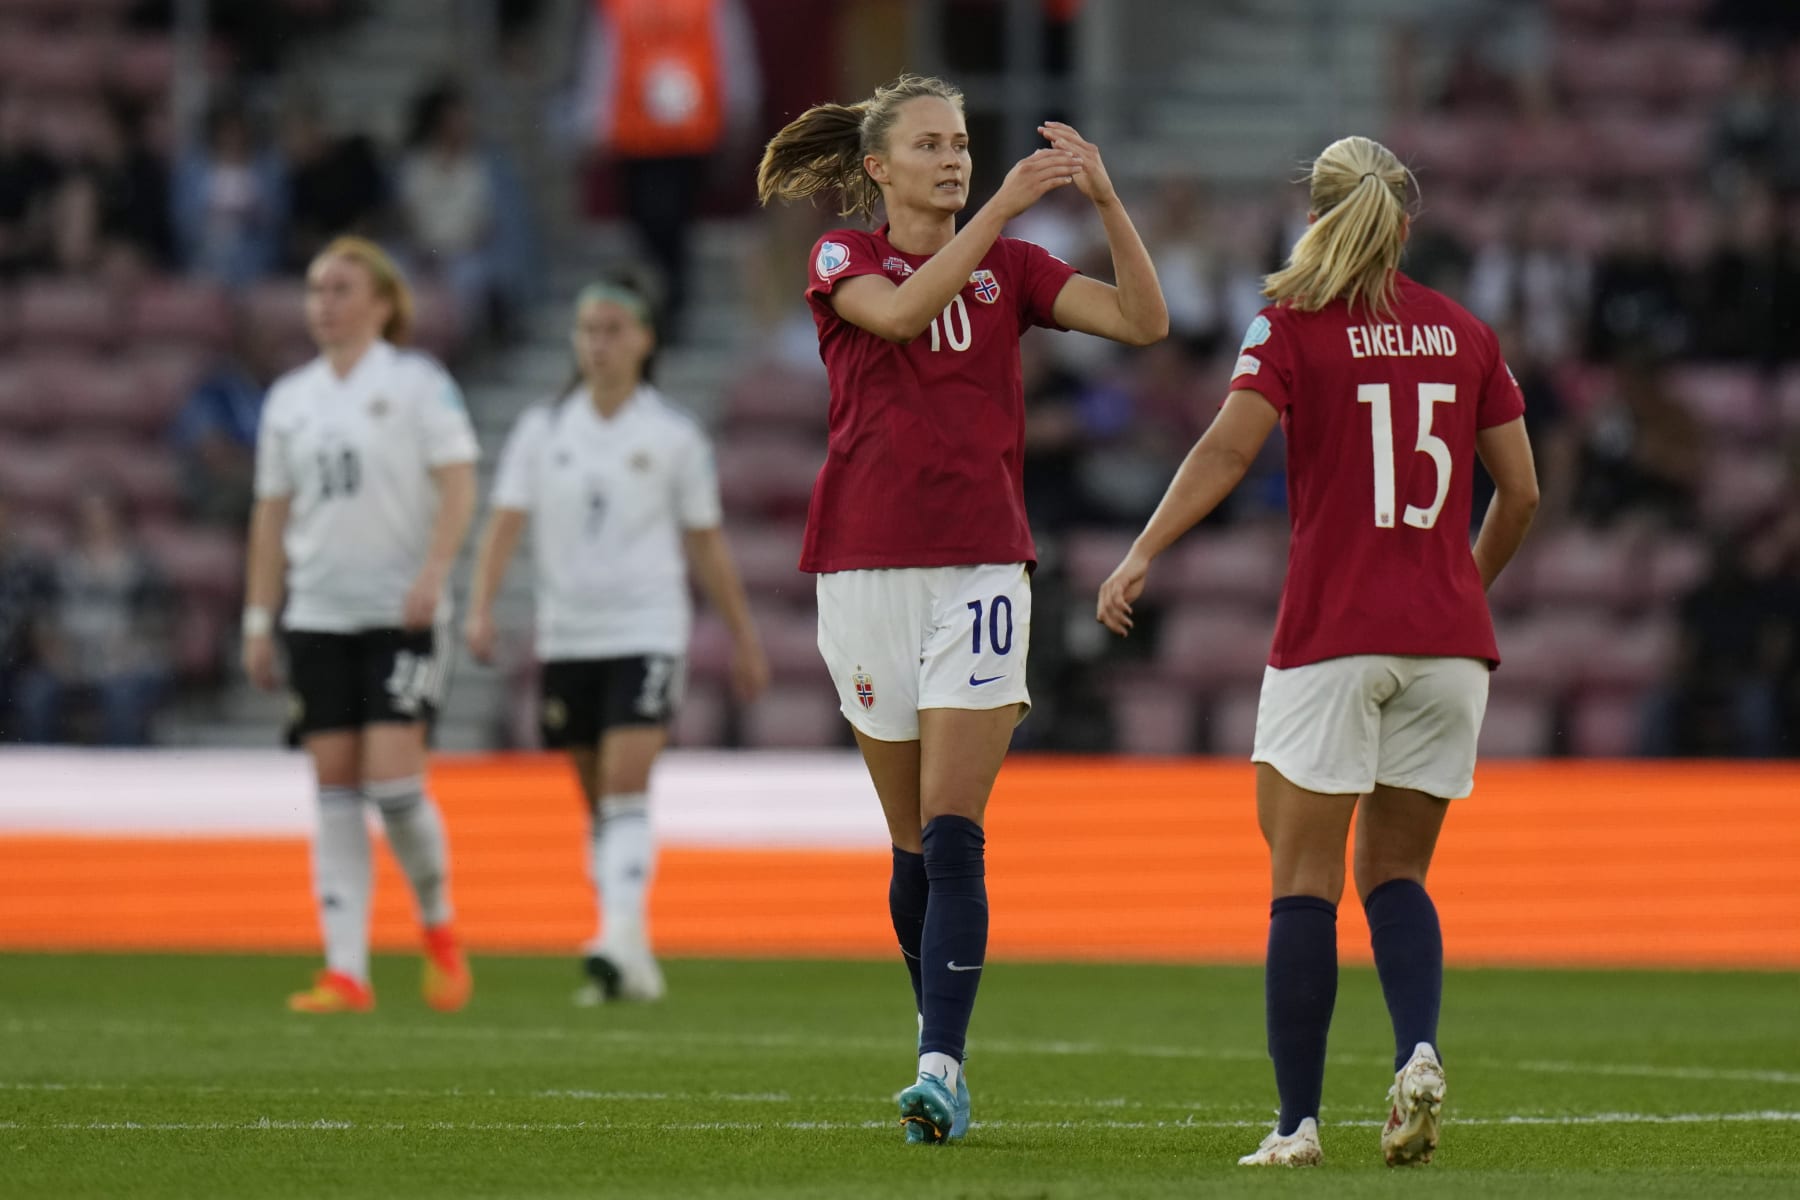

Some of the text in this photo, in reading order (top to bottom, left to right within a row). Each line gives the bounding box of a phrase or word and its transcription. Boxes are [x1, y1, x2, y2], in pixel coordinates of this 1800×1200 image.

[930, 293, 972, 352] 10
[1346, 324, 1457, 358] EIKELAND
[1357, 382, 1457, 530] 15
[967, 595, 1013, 655] 10
